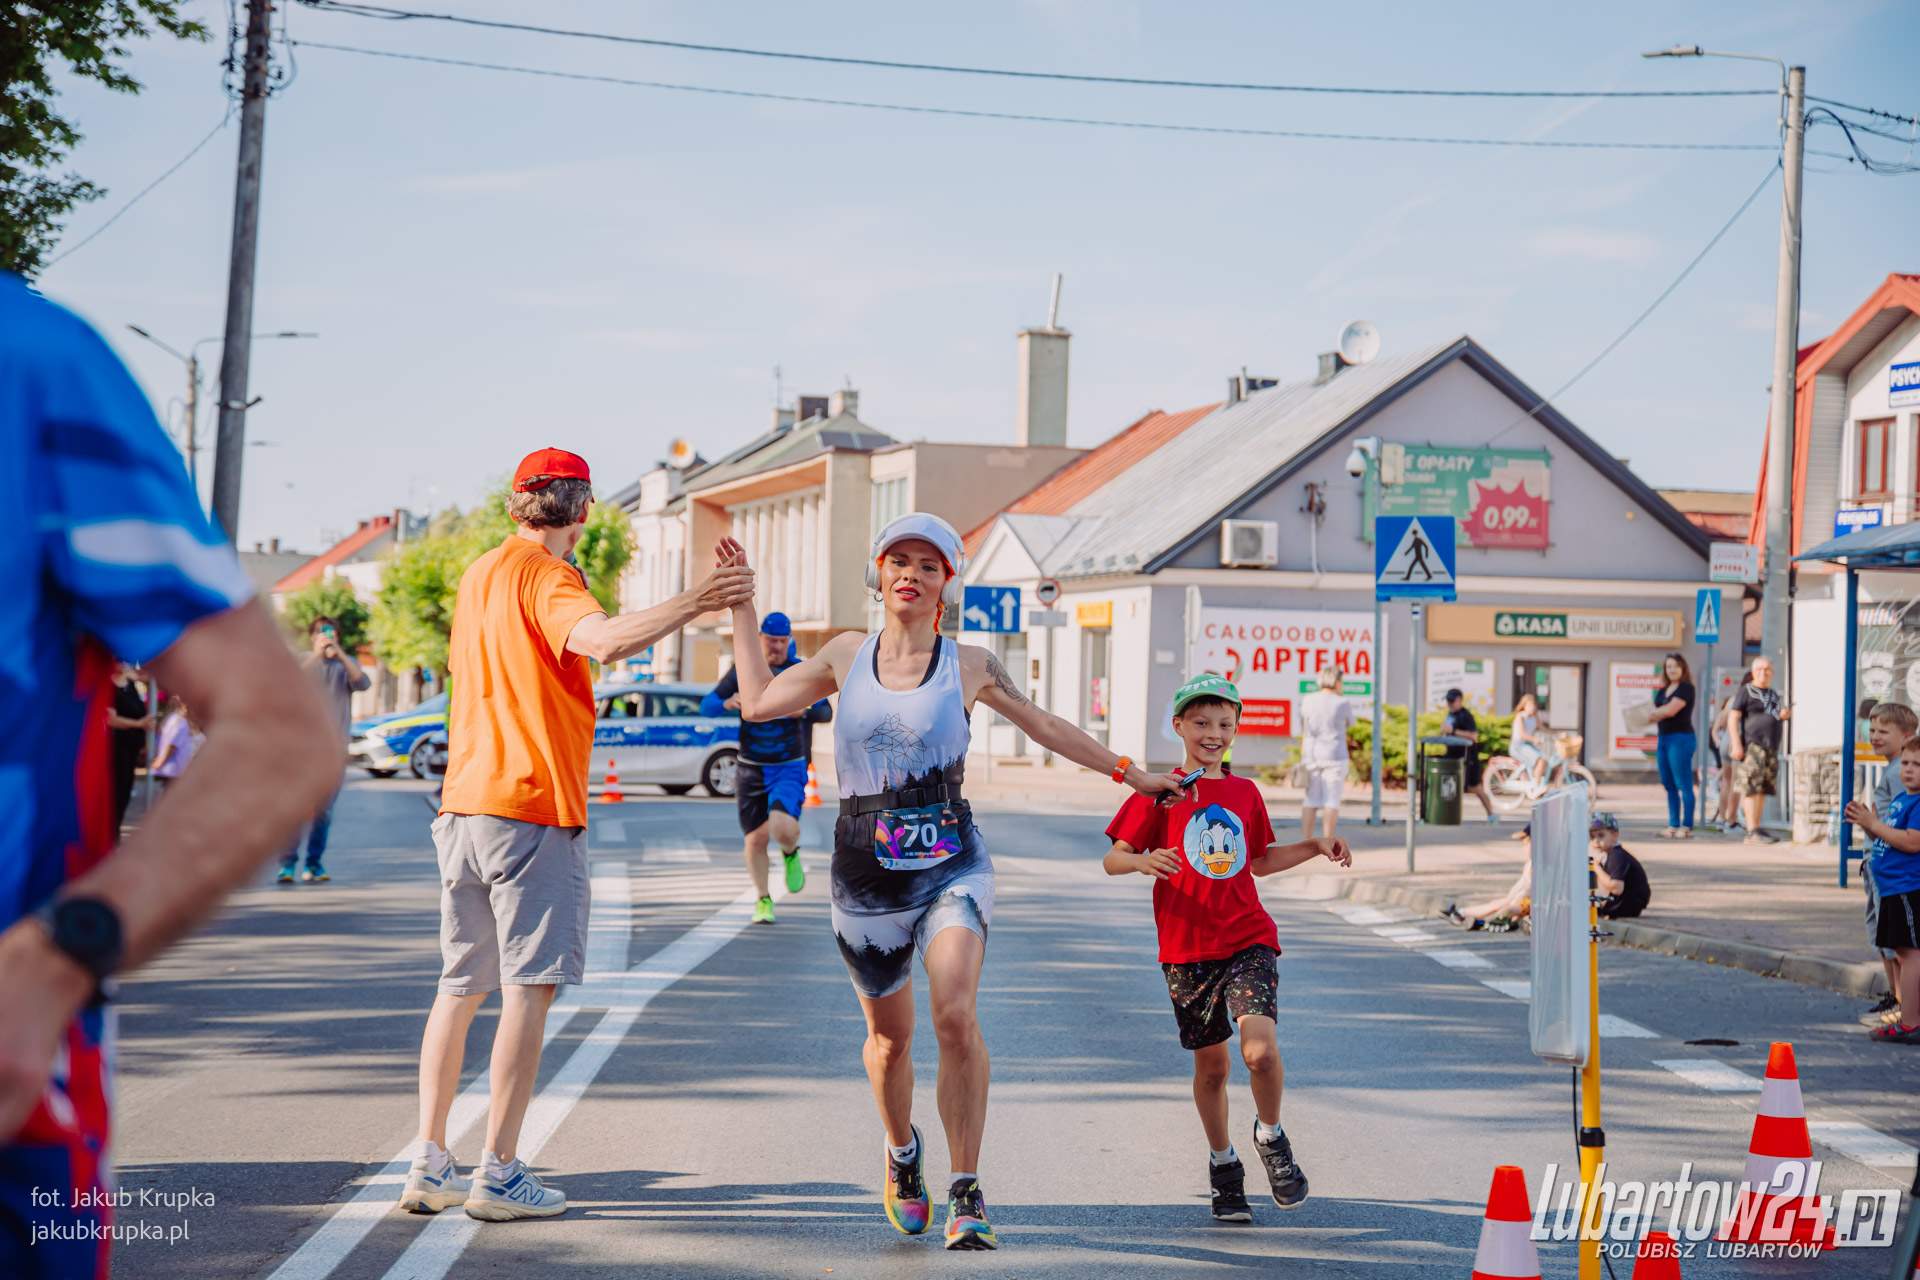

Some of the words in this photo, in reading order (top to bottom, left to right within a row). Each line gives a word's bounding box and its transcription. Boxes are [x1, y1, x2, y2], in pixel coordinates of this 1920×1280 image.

[1205, 623, 1373, 643] CAŁODOBOWA
[1517, 617, 1564, 634] KASA
[1572, 621, 1600, 633] UNII
[1604, 622, 1670, 636] LUBELSKIEJ
[1252, 646, 1371, 675] APTEKA
[904, 823, 938, 848] 70
